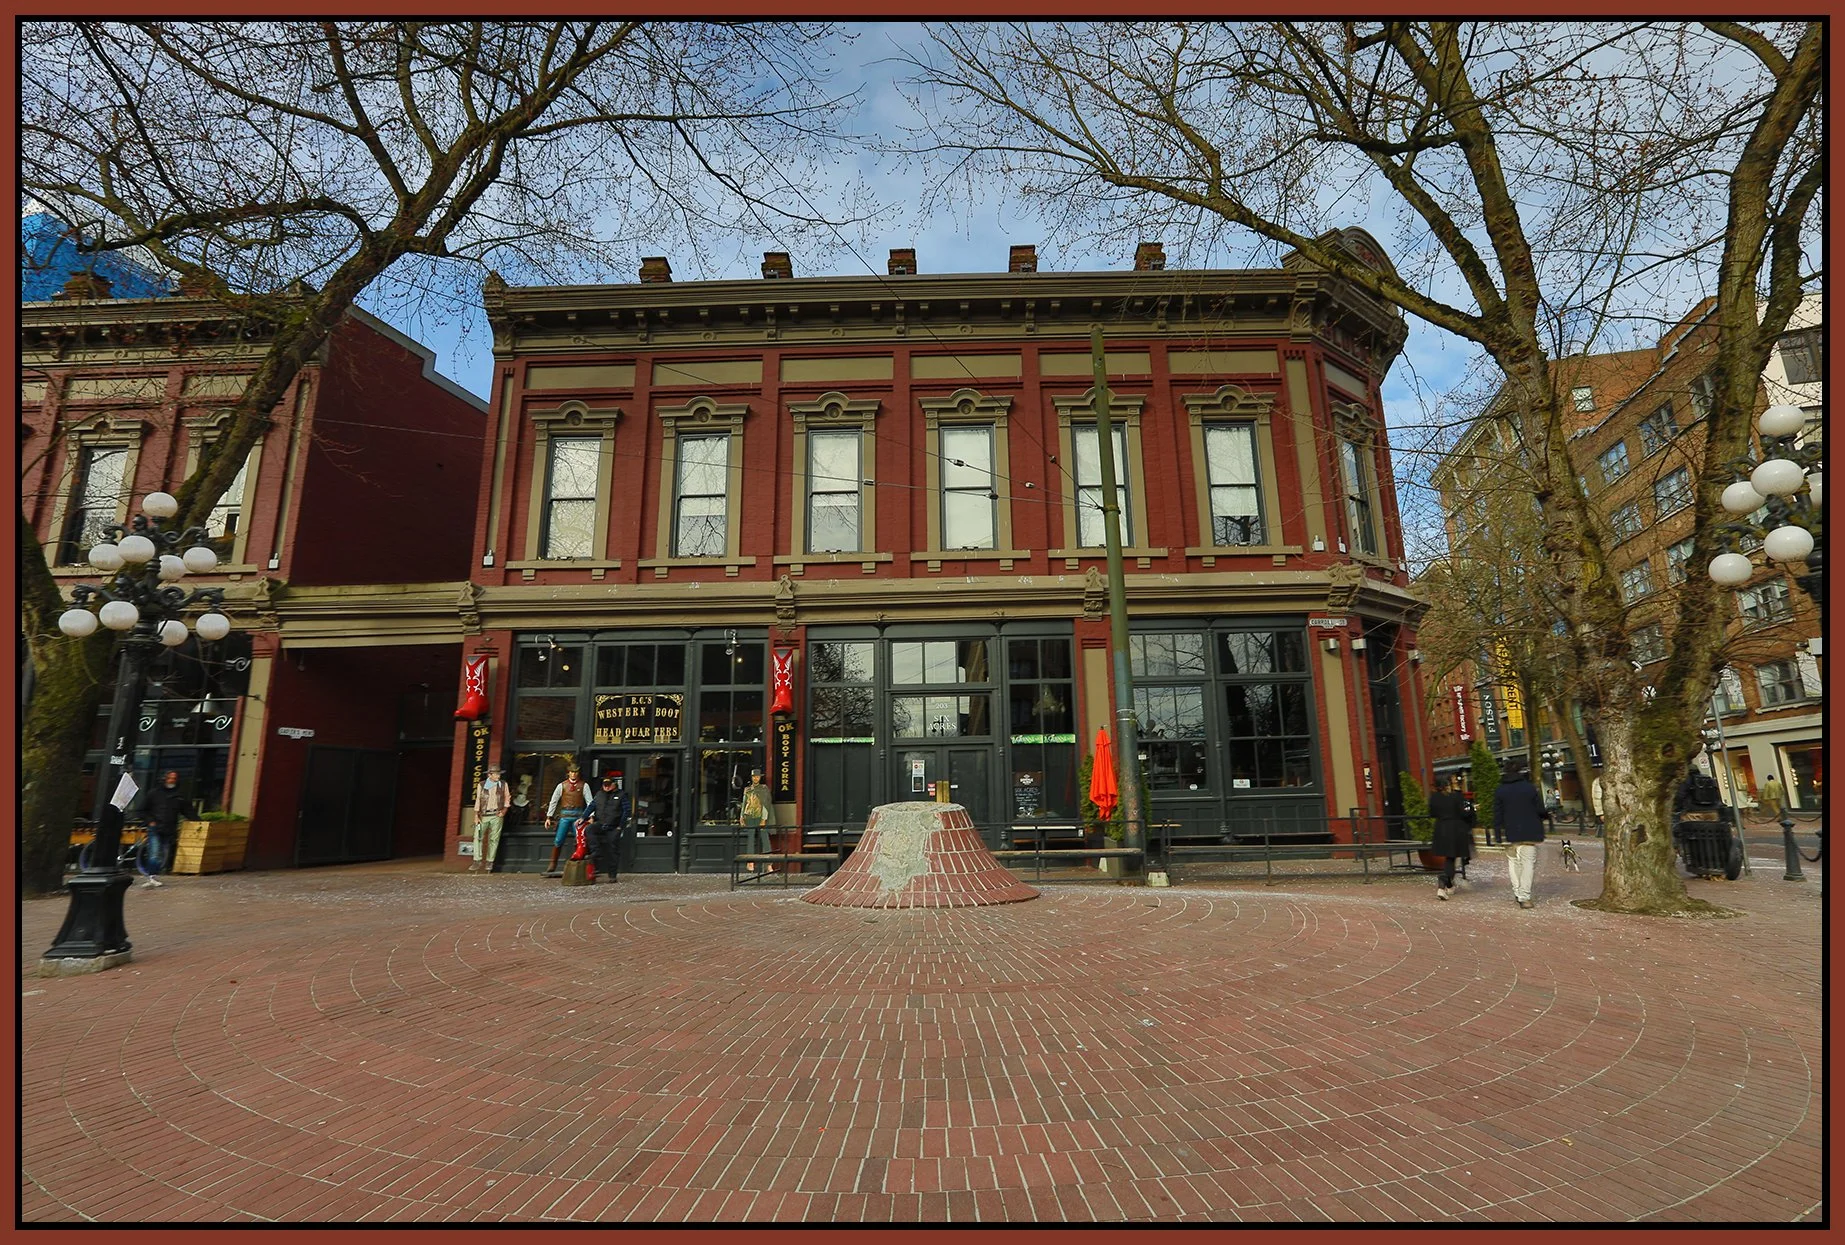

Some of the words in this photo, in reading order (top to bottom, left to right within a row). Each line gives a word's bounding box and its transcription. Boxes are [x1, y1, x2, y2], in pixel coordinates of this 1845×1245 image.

[598, 707, 646, 720] WESTERN
[655, 707, 680, 719] BOOT
[933, 714, 950, 722] SIX
[1483, 694, 1497, 733] FILSON
[473, 727, 489, 737] OK
[778, 722, 794, 733] OK
[475, 738, 485, 762] BOOT
[781, 733, 790, 758] BOOT
